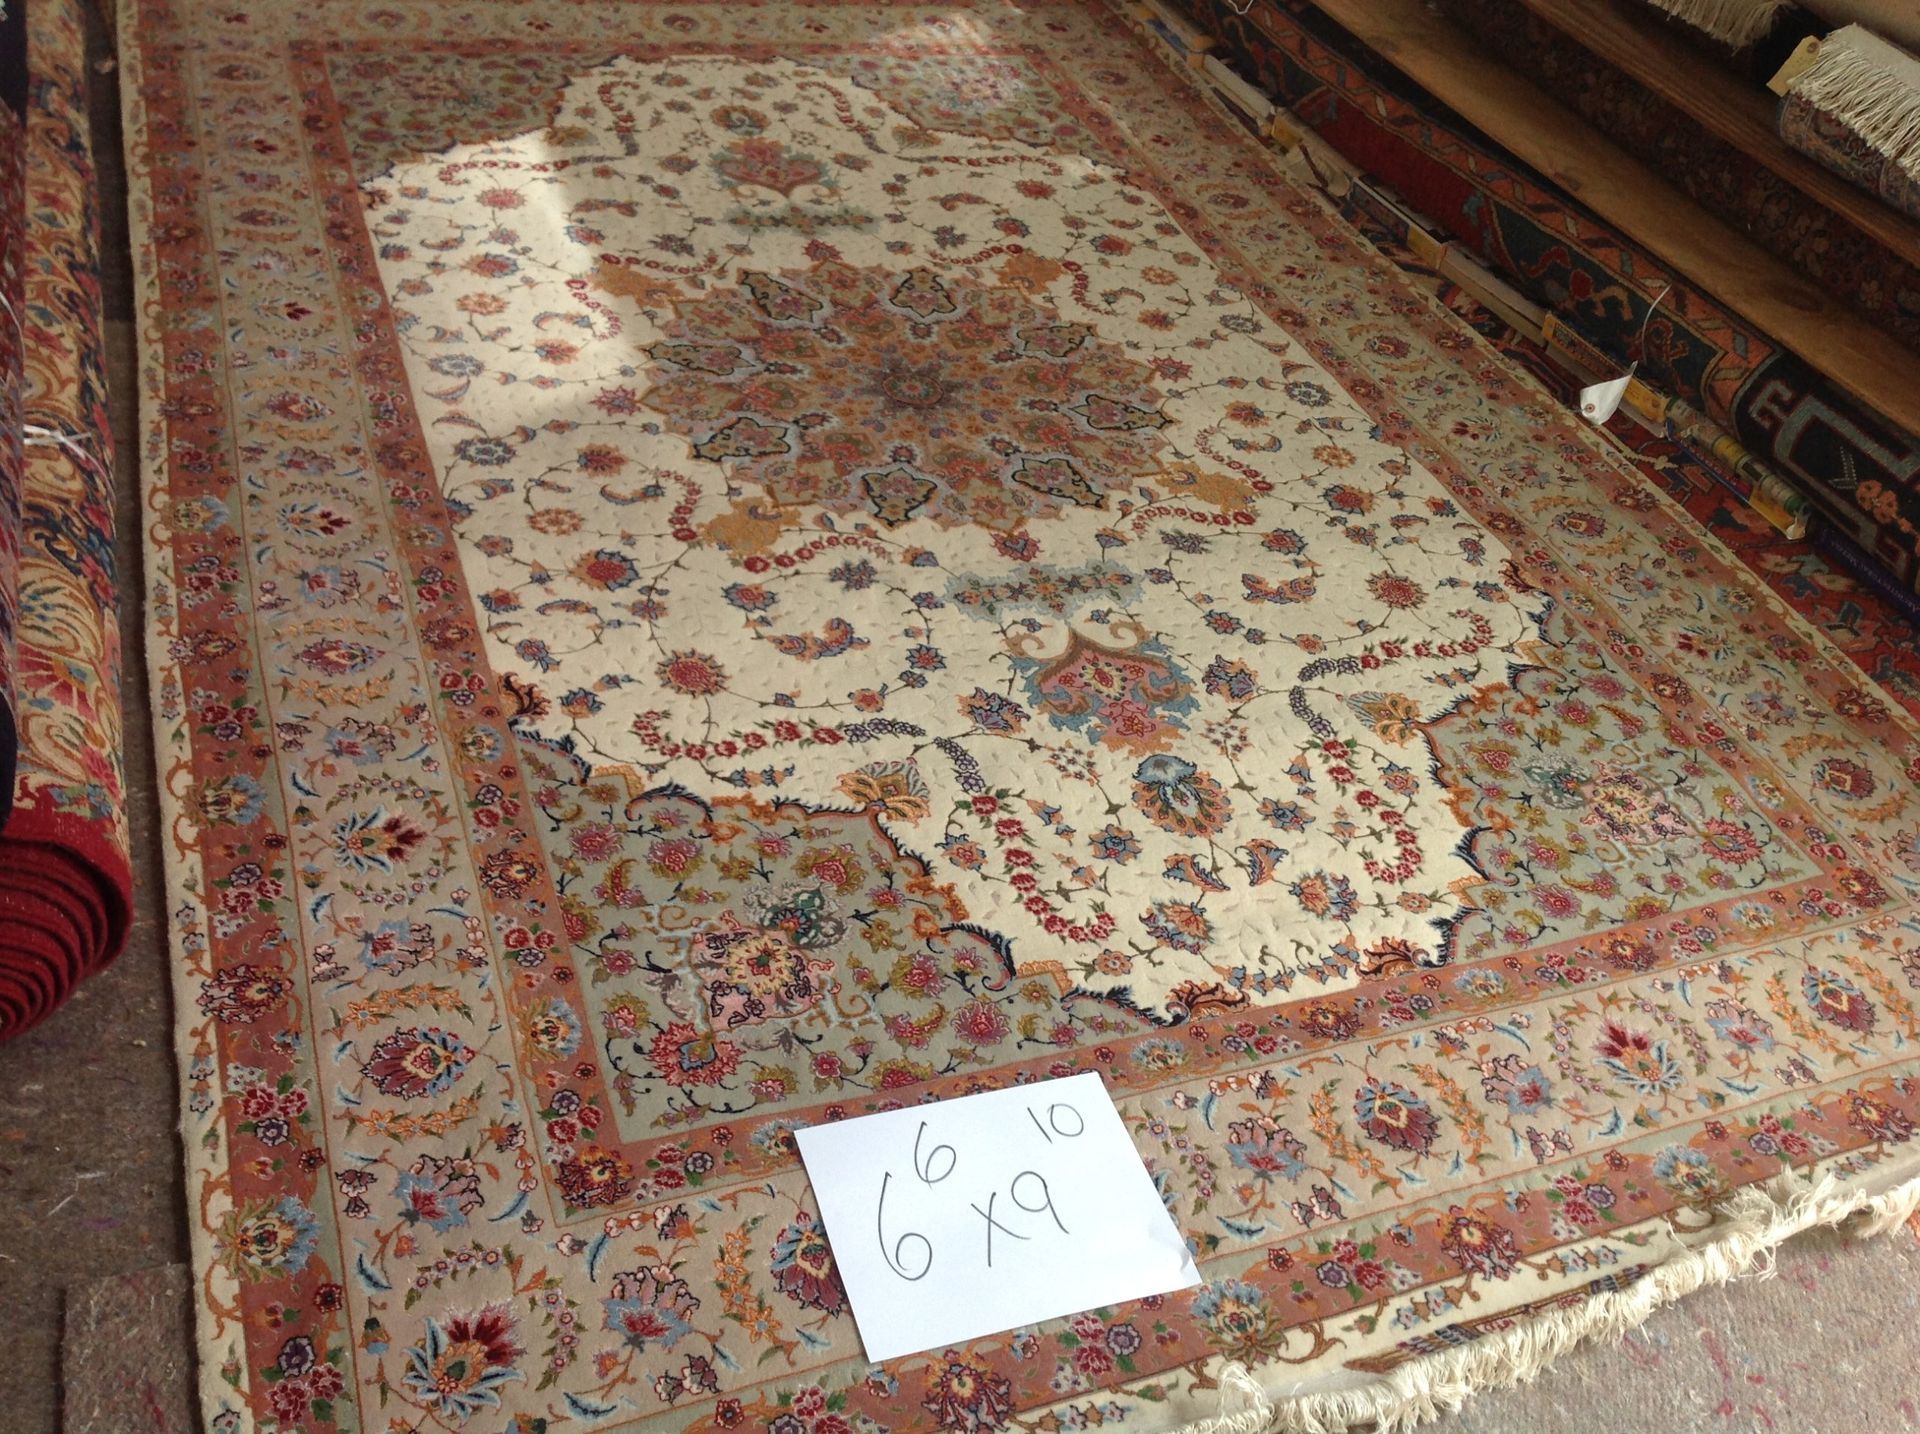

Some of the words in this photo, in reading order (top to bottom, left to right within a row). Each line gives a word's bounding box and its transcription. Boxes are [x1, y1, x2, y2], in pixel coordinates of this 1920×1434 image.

[914, 1121, 957, 1189] 6
[1027, 1103, 1084, 1144] 10
[878, 1171, 932, 1281] 6
